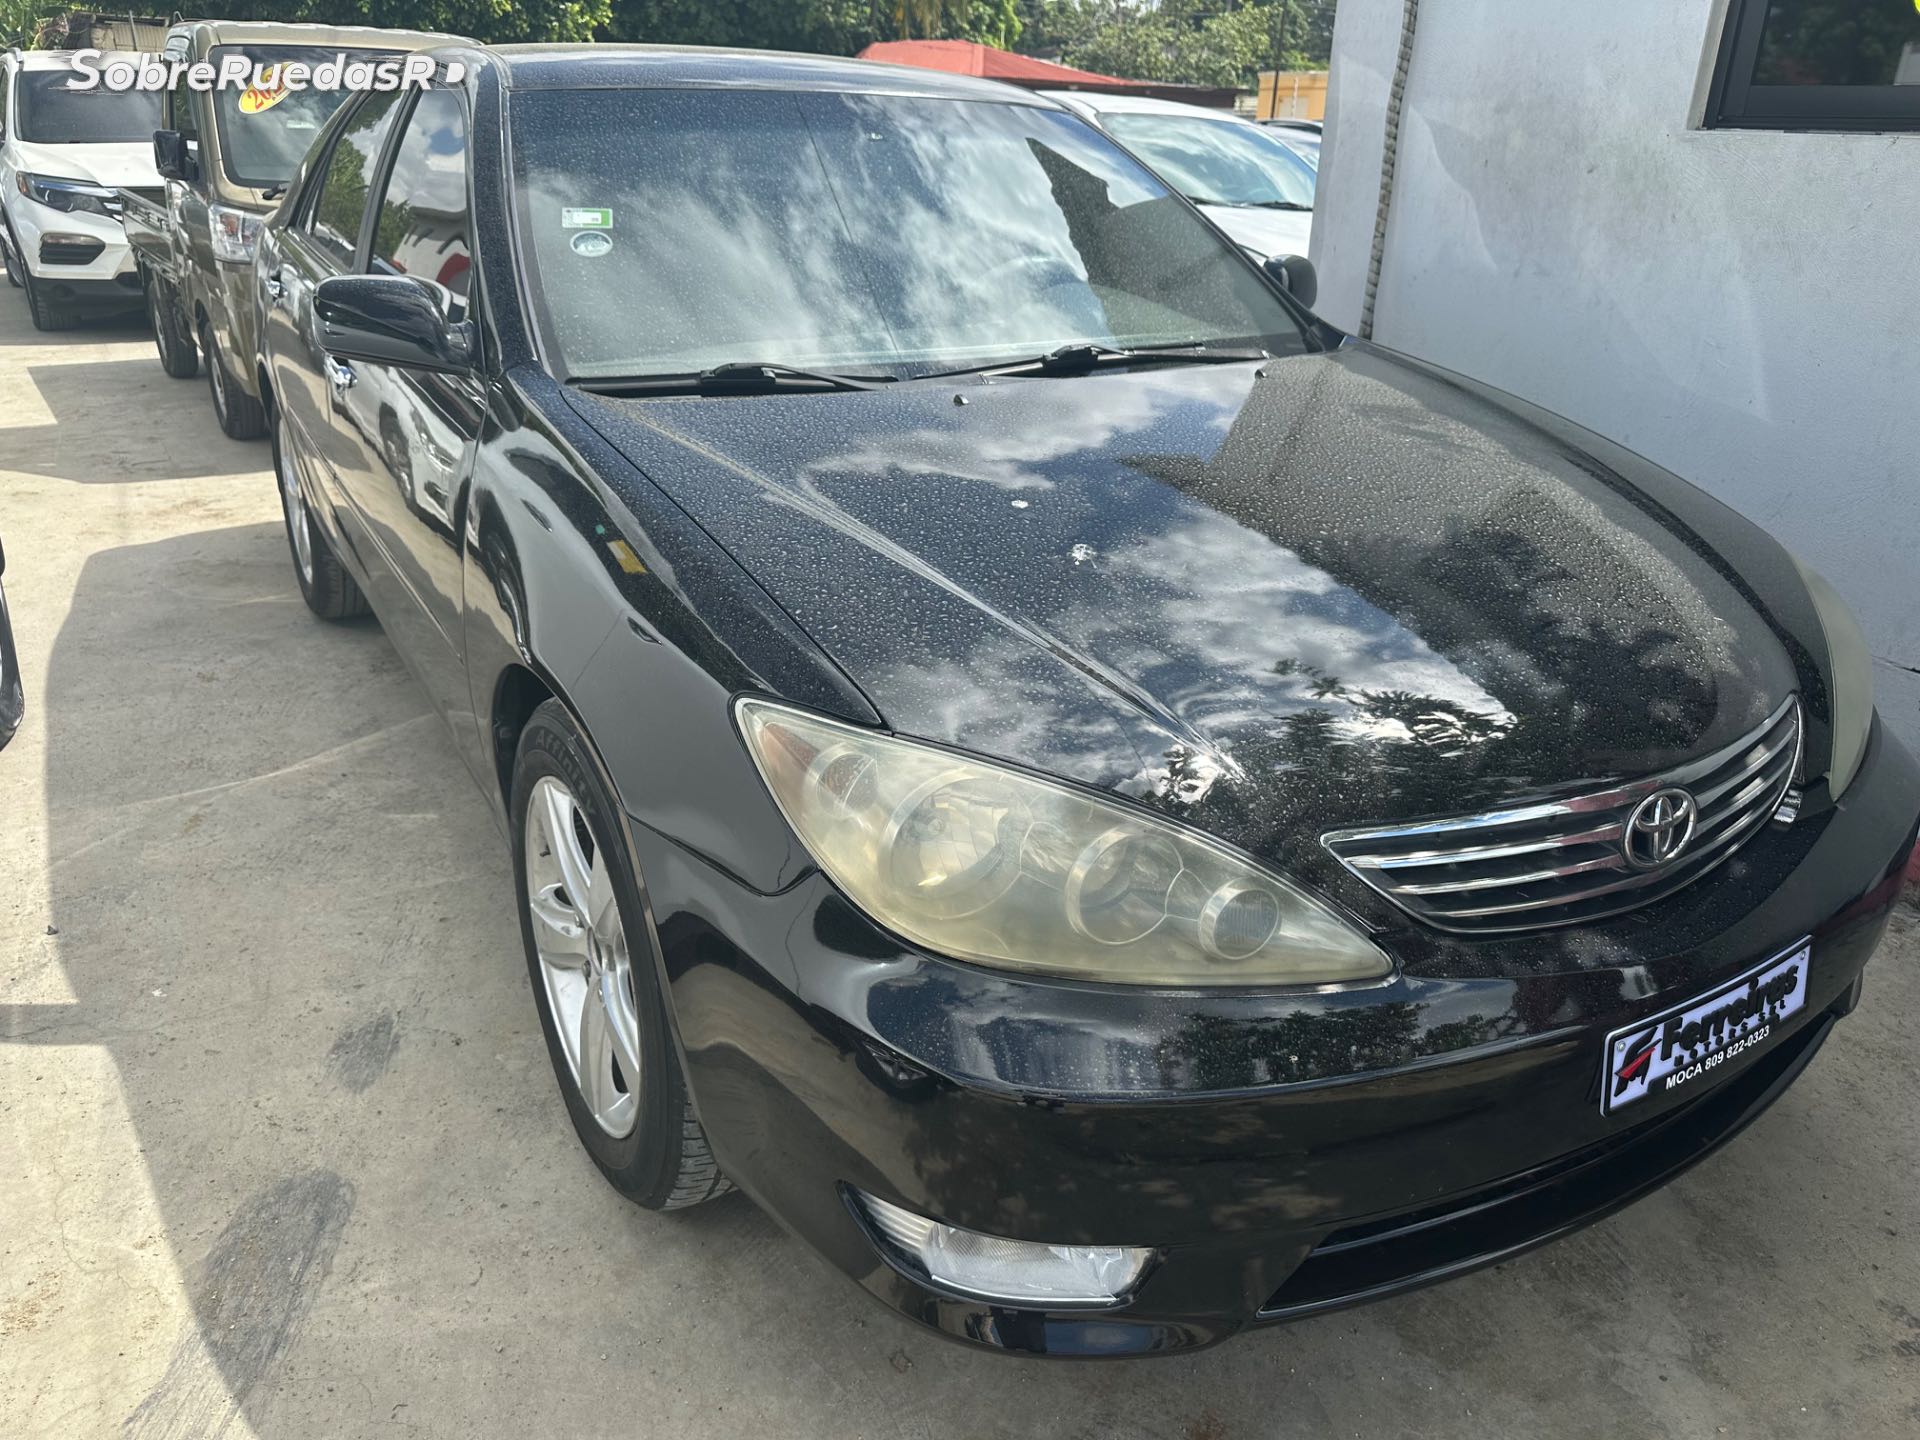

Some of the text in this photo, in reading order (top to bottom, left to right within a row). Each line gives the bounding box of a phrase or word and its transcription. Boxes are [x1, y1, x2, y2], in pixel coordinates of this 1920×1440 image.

[536, 729, 597, 815] Affinity
[1665, 1024, 1770, 1090] MOCA 809 822-0323
